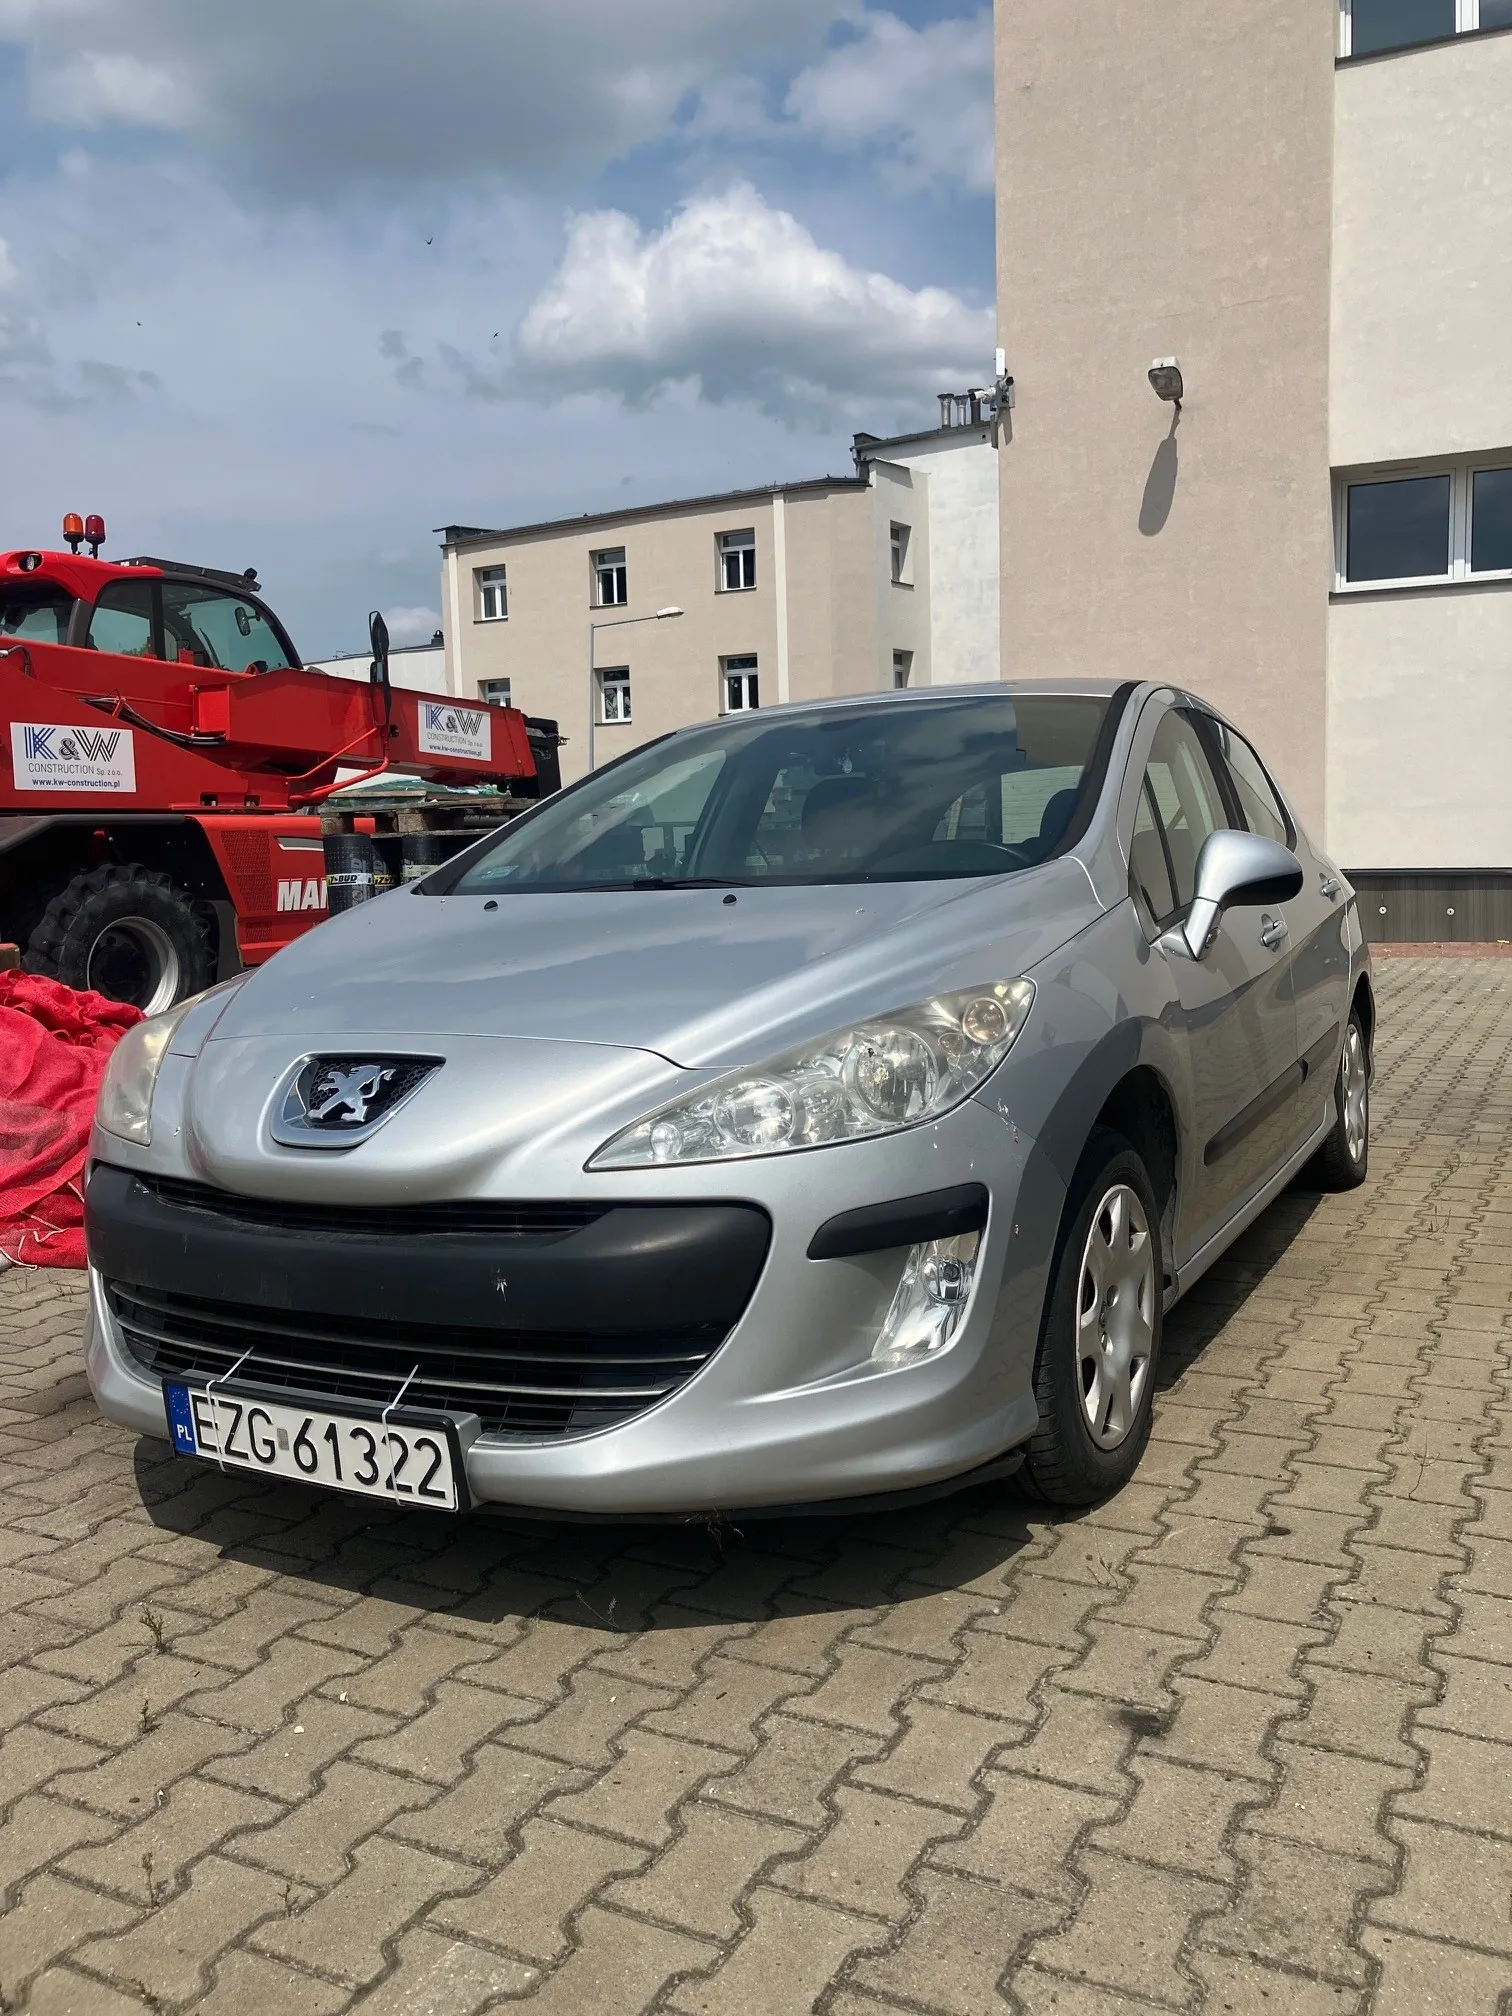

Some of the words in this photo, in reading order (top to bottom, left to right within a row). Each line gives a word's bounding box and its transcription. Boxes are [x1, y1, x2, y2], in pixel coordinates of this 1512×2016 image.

[427, 732, 467, 745] CONSTRUCTION
[429, 744, 482, 757] www.kw-construction.pl
[28, 762, 95, 774] CONSTRUCTION
[32, 778, 121, 788] www.kw-construction.pl
[177, 1423, 193, 1442] PL
[191, 1394, 276, 1464] EZG
[293, 1417, 446, 1499] 61322
